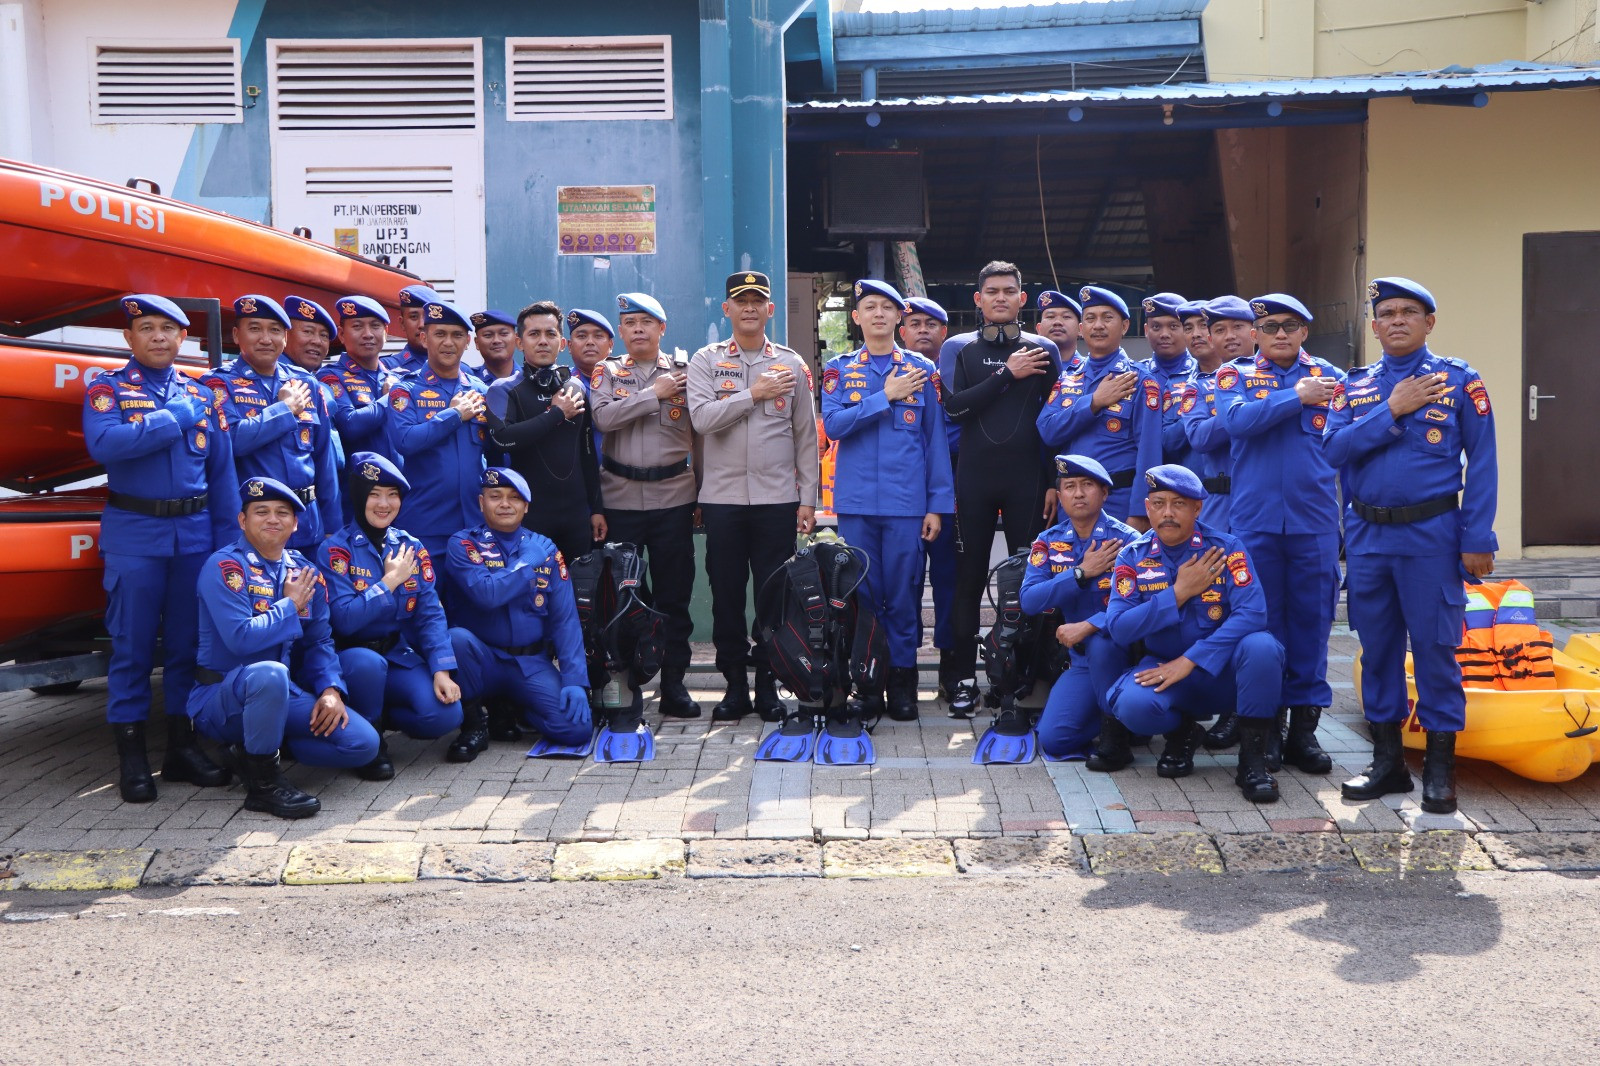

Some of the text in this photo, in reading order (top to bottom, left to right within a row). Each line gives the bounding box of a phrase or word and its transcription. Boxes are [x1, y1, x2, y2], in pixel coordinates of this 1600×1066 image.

[40, 182, 165, 234] POLISI
[611, 202, 651, 212] SELAMAT
[363, 242, 431, 254] BANDENGAN
[714, 370, 743, 379] ZAROKI
[845, 380, 867, 389] ALDI
[416, 400, 446, 408] TRI BROTO
[248, 585, 274, 597] FIRMAN
